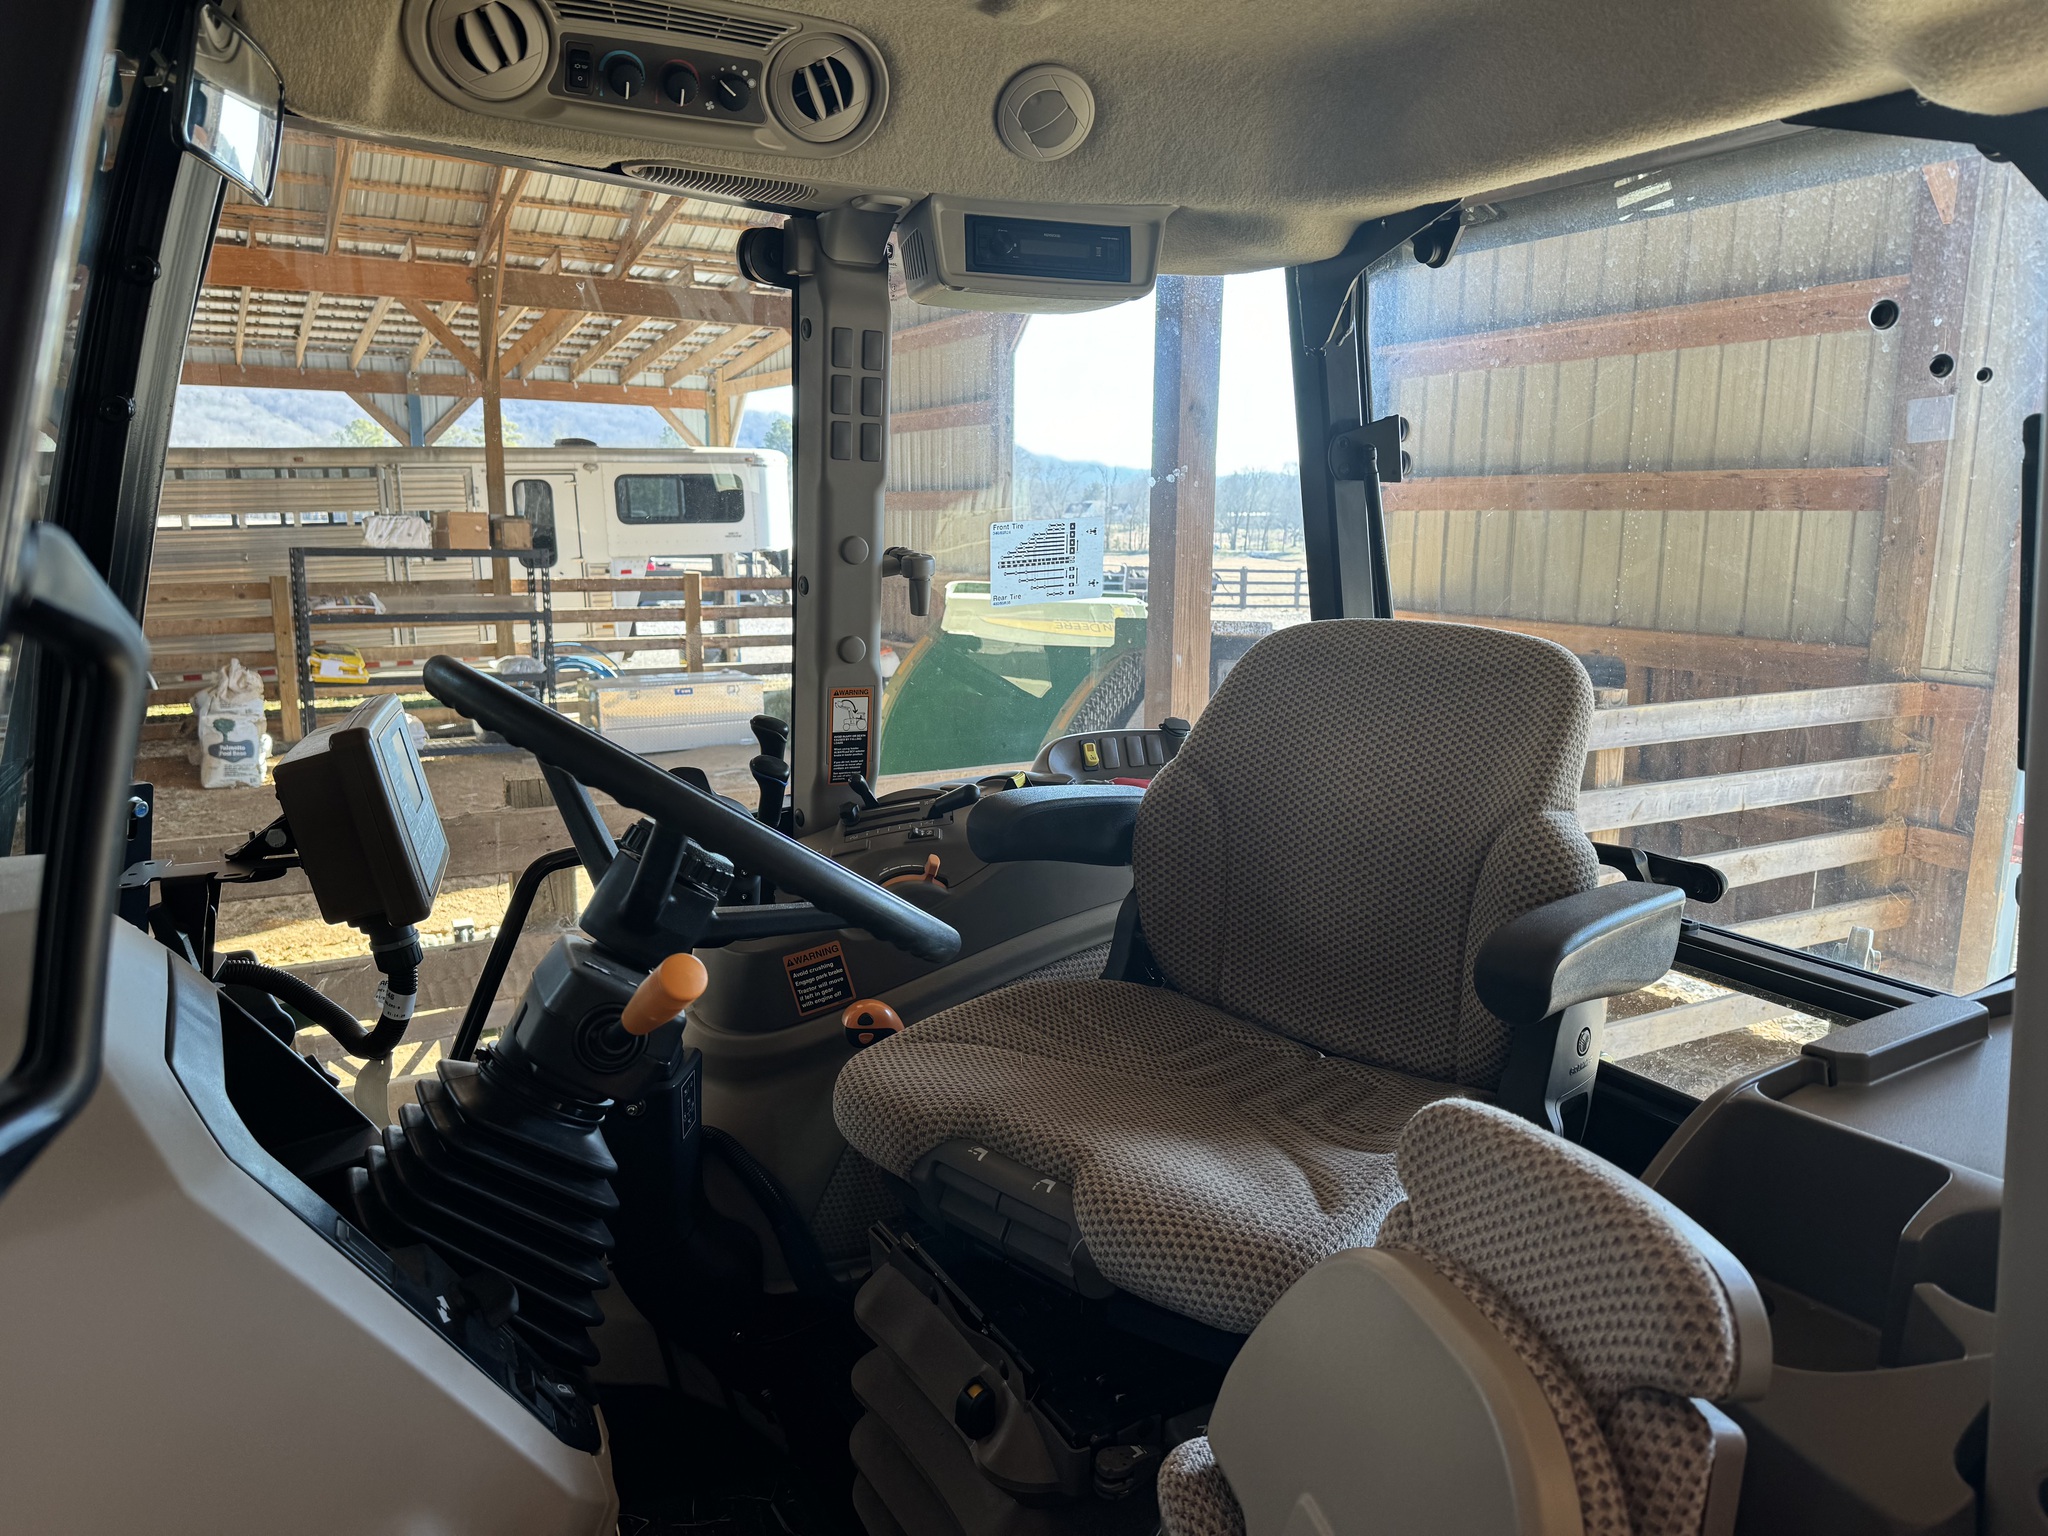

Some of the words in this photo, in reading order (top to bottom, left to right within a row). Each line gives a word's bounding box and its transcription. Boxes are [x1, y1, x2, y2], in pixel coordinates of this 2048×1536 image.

[1056, 622, 1101, 632] DEERE
[793, 945, 839, 965] WARNING
[793, 970, 809, 978] Avoid
[809, 962, 834, 973] crushing
[795, 977, 815, 987] Engage
[815, 973, 828, 981] park
[828, 968, 843, 976] brake
[798, 986, 817, 994] Tractor
[828, 977, 844, 985] move
[804, 992, 814, 1000] left
[821, 987, 834, 996] gear
[802, 1000, 814, 1008] with
[814, 994, 833, 1004] engine
[833, 990, 842, 998] off
